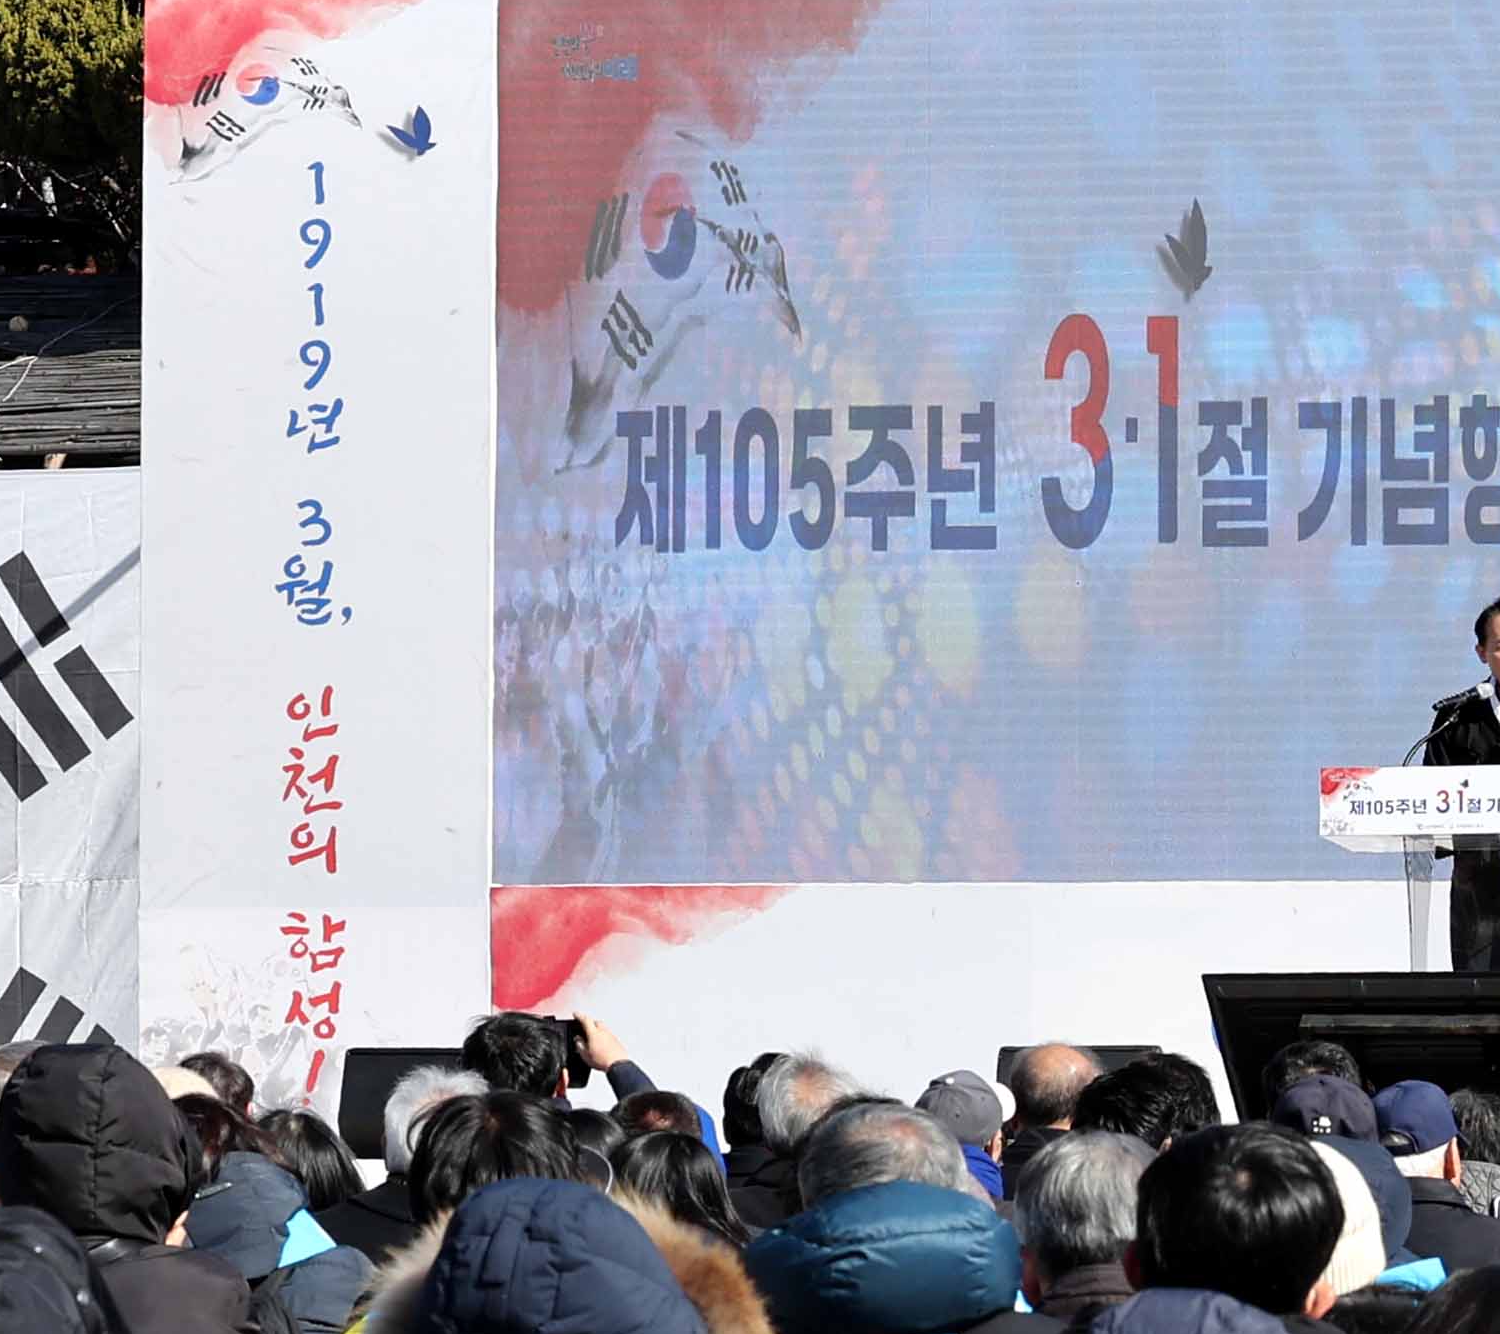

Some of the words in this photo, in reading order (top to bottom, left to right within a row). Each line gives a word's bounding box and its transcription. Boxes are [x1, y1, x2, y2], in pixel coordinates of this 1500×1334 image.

[285, 160, 344, 454] 1919년
[274, 498, 353, 627] 3월,
[614, 397, 998, 555] 제105주년
[281, 684, 343, 875] 인천의
[1349, 797, 1427, 816] 제105주년
[279, 911, 347, 1106] 함성!
